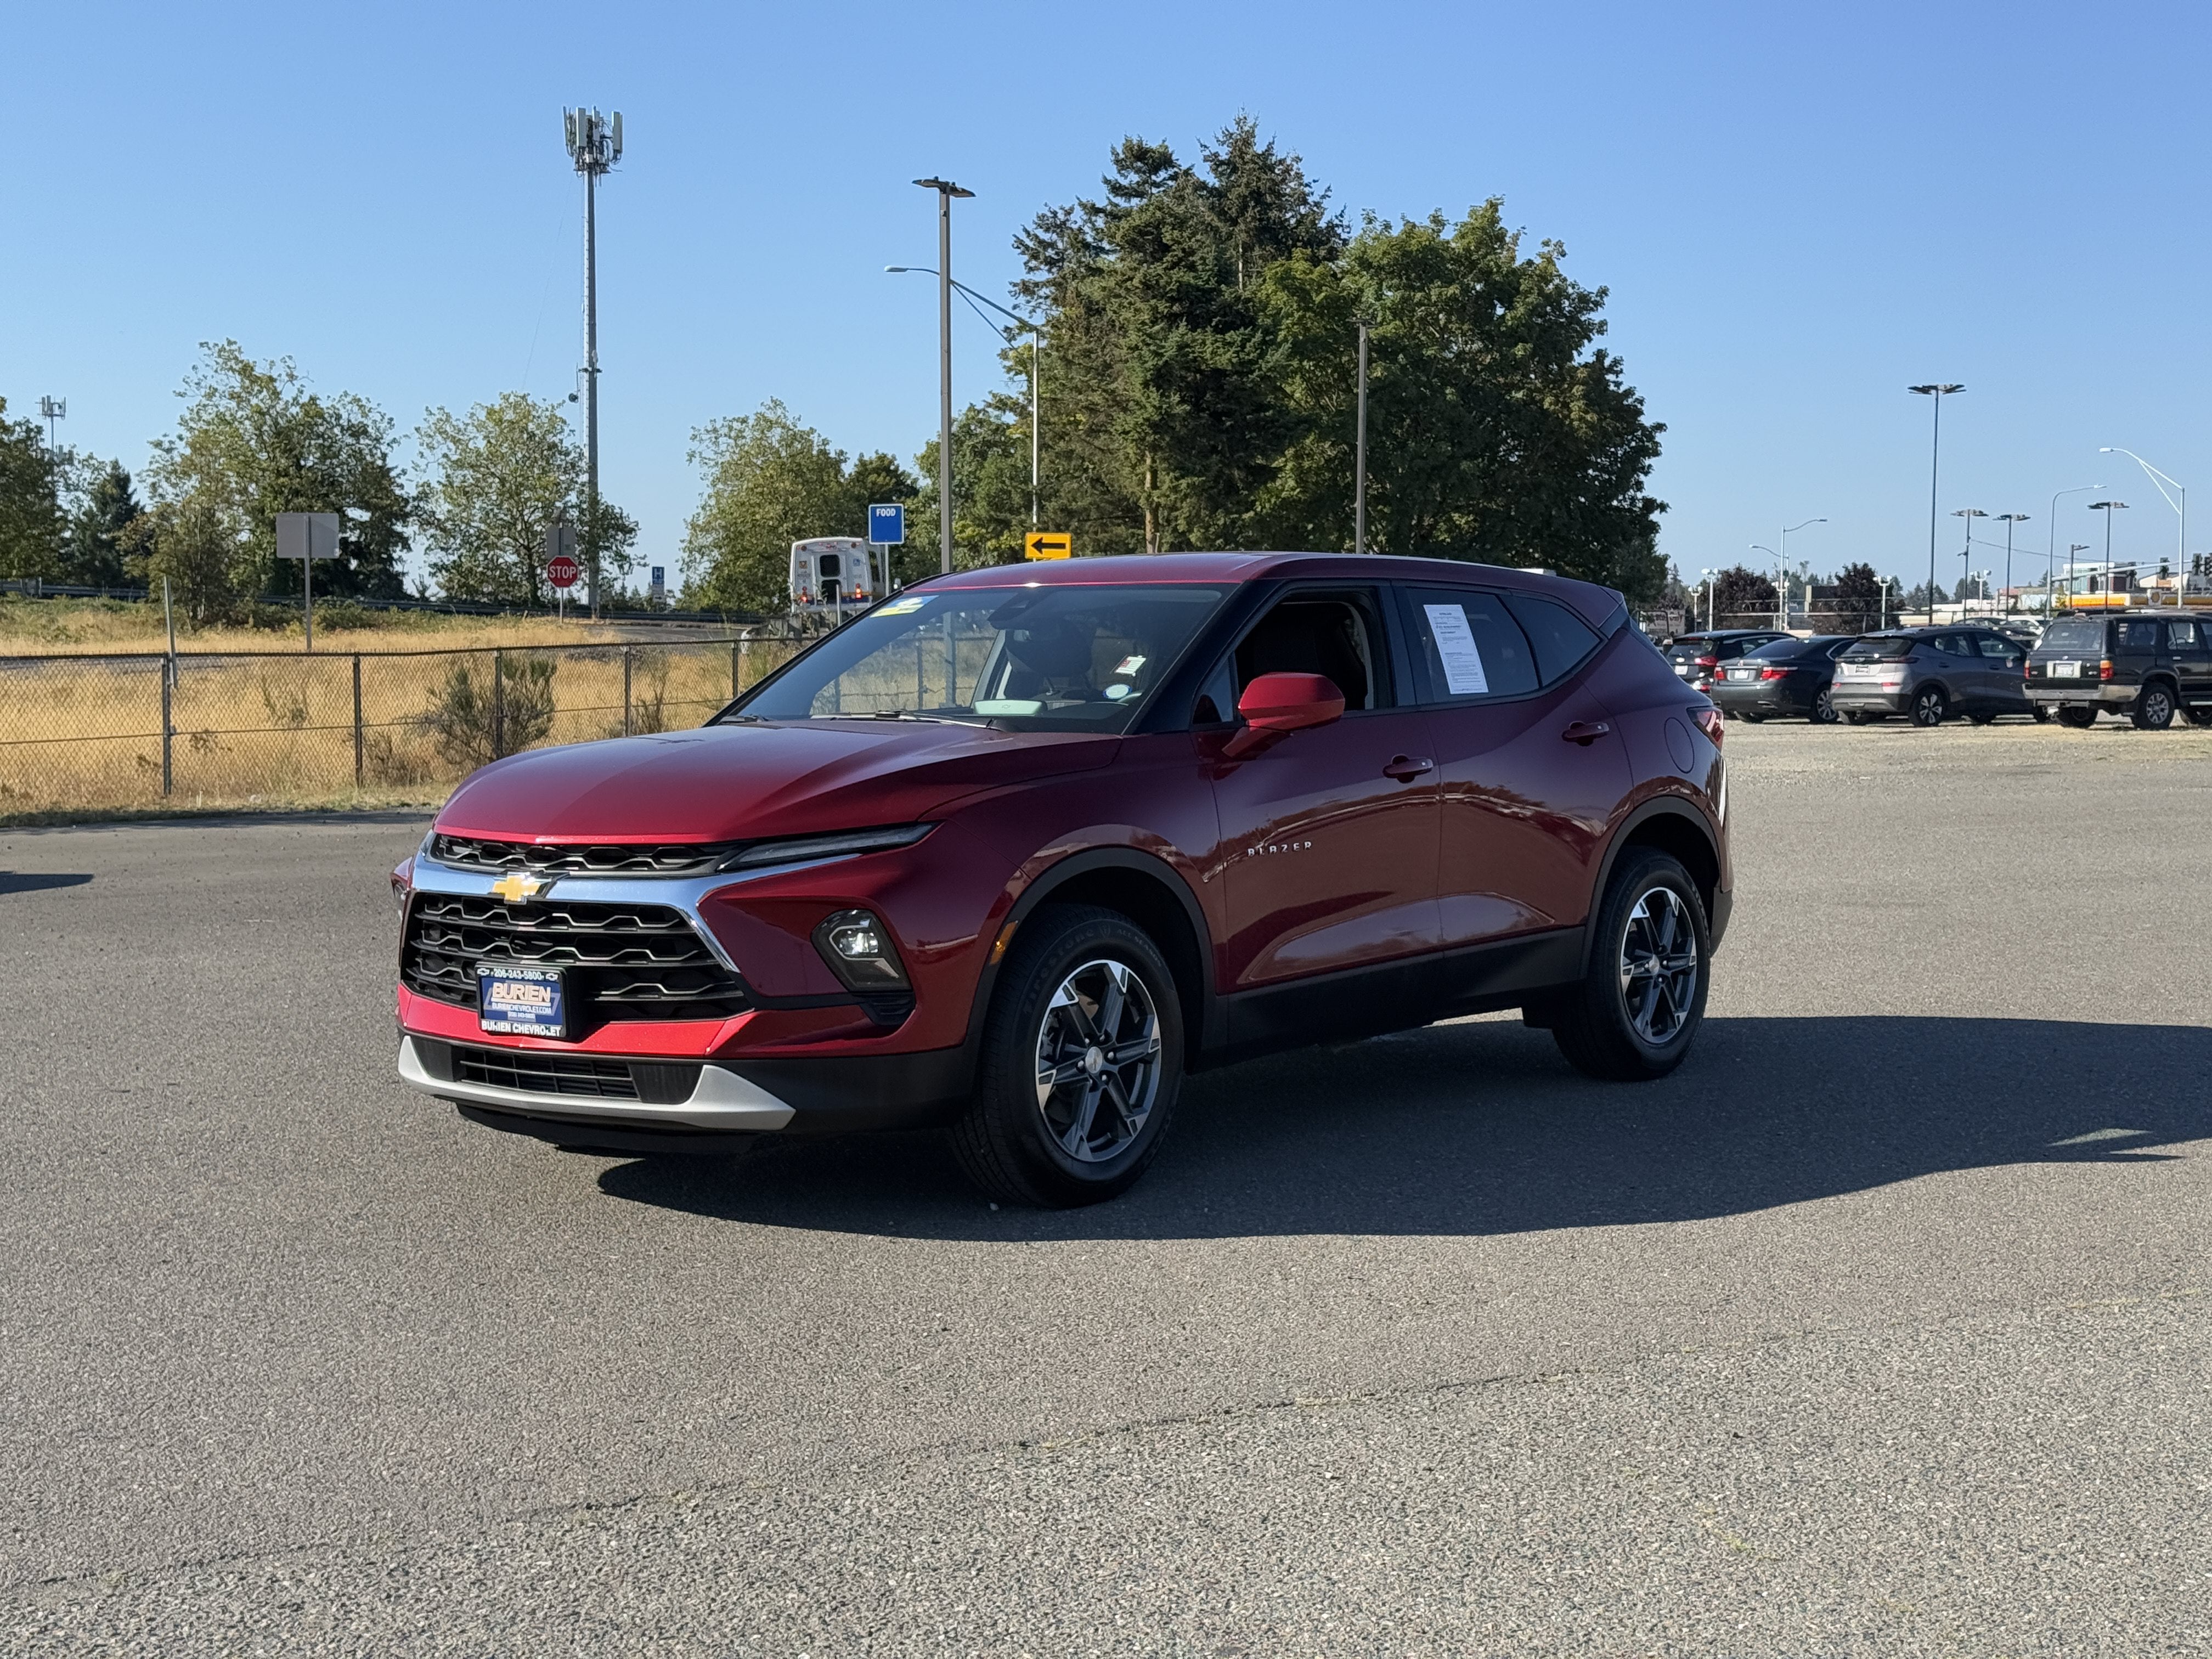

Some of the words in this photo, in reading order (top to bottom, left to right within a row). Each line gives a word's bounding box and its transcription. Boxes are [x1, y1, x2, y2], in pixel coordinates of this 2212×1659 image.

[876, 508, 896, 517] FOOD
[549, 566, 577, 579] STOP
[654, 568, 662, 578] H
[1248, 841, 1312, 856] BLAZER
[493, 982, 551, 1002] BURIEN
[481, 1020, 511, 1032] BURIEN
[512, 1023, 561, 1037] CHEVROLET
